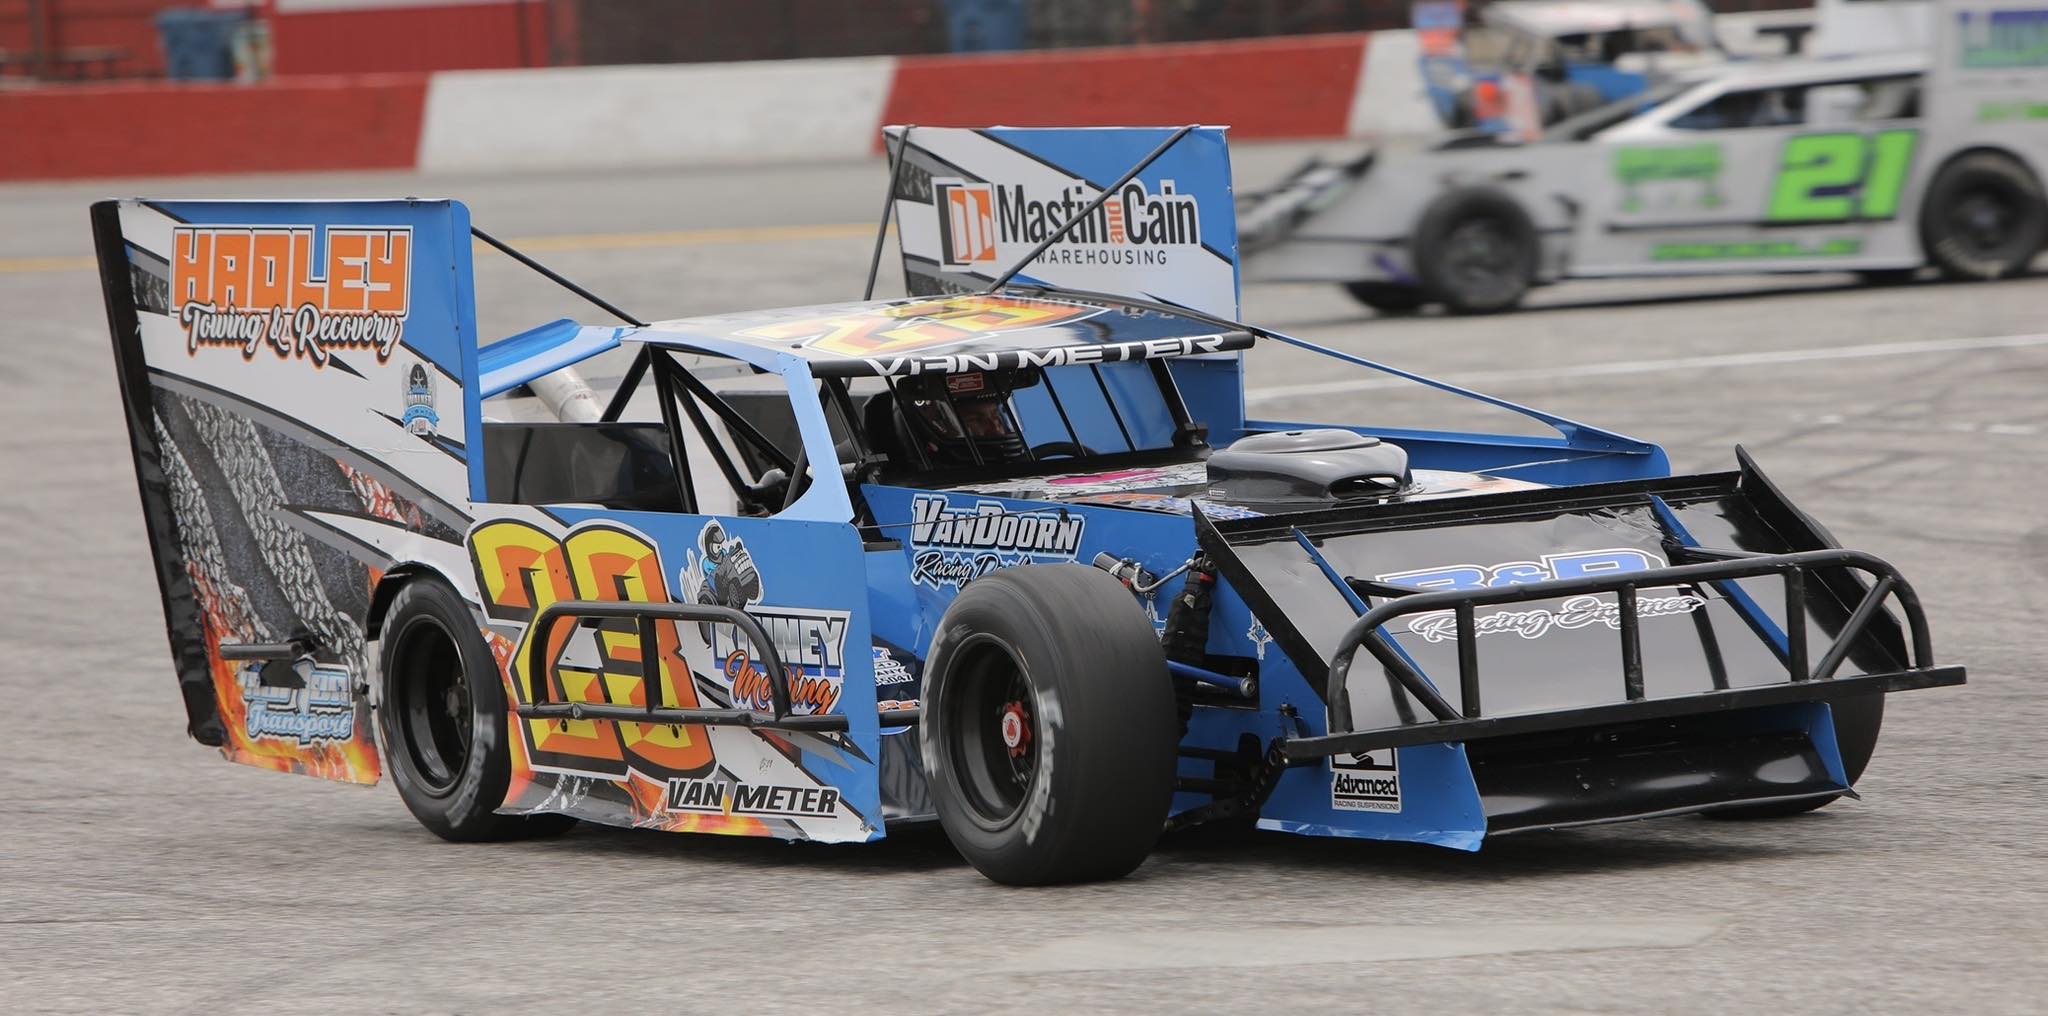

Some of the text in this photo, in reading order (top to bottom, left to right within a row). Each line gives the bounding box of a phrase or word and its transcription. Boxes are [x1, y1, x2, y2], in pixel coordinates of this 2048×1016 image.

[1766, 131, 1918, 221] 21
[997, 183, 1197, 245] Mastin and Cain
[173, 228, 410, 316] HADLEY
[182, 300, 400, 361] Towing & Recovery
[863, 333, 1226, 376] VAN METER
[914, 552, 971, 588] Racing
[467, 519, 717, 775] 23
[247, 701, 353, 743] Transport
[668, 780, 838, 814] VAN METER
[1334, 773, 1398, 795] Advanced
[1334, 800, 1399, 811] RACING SUSPENSIONS
